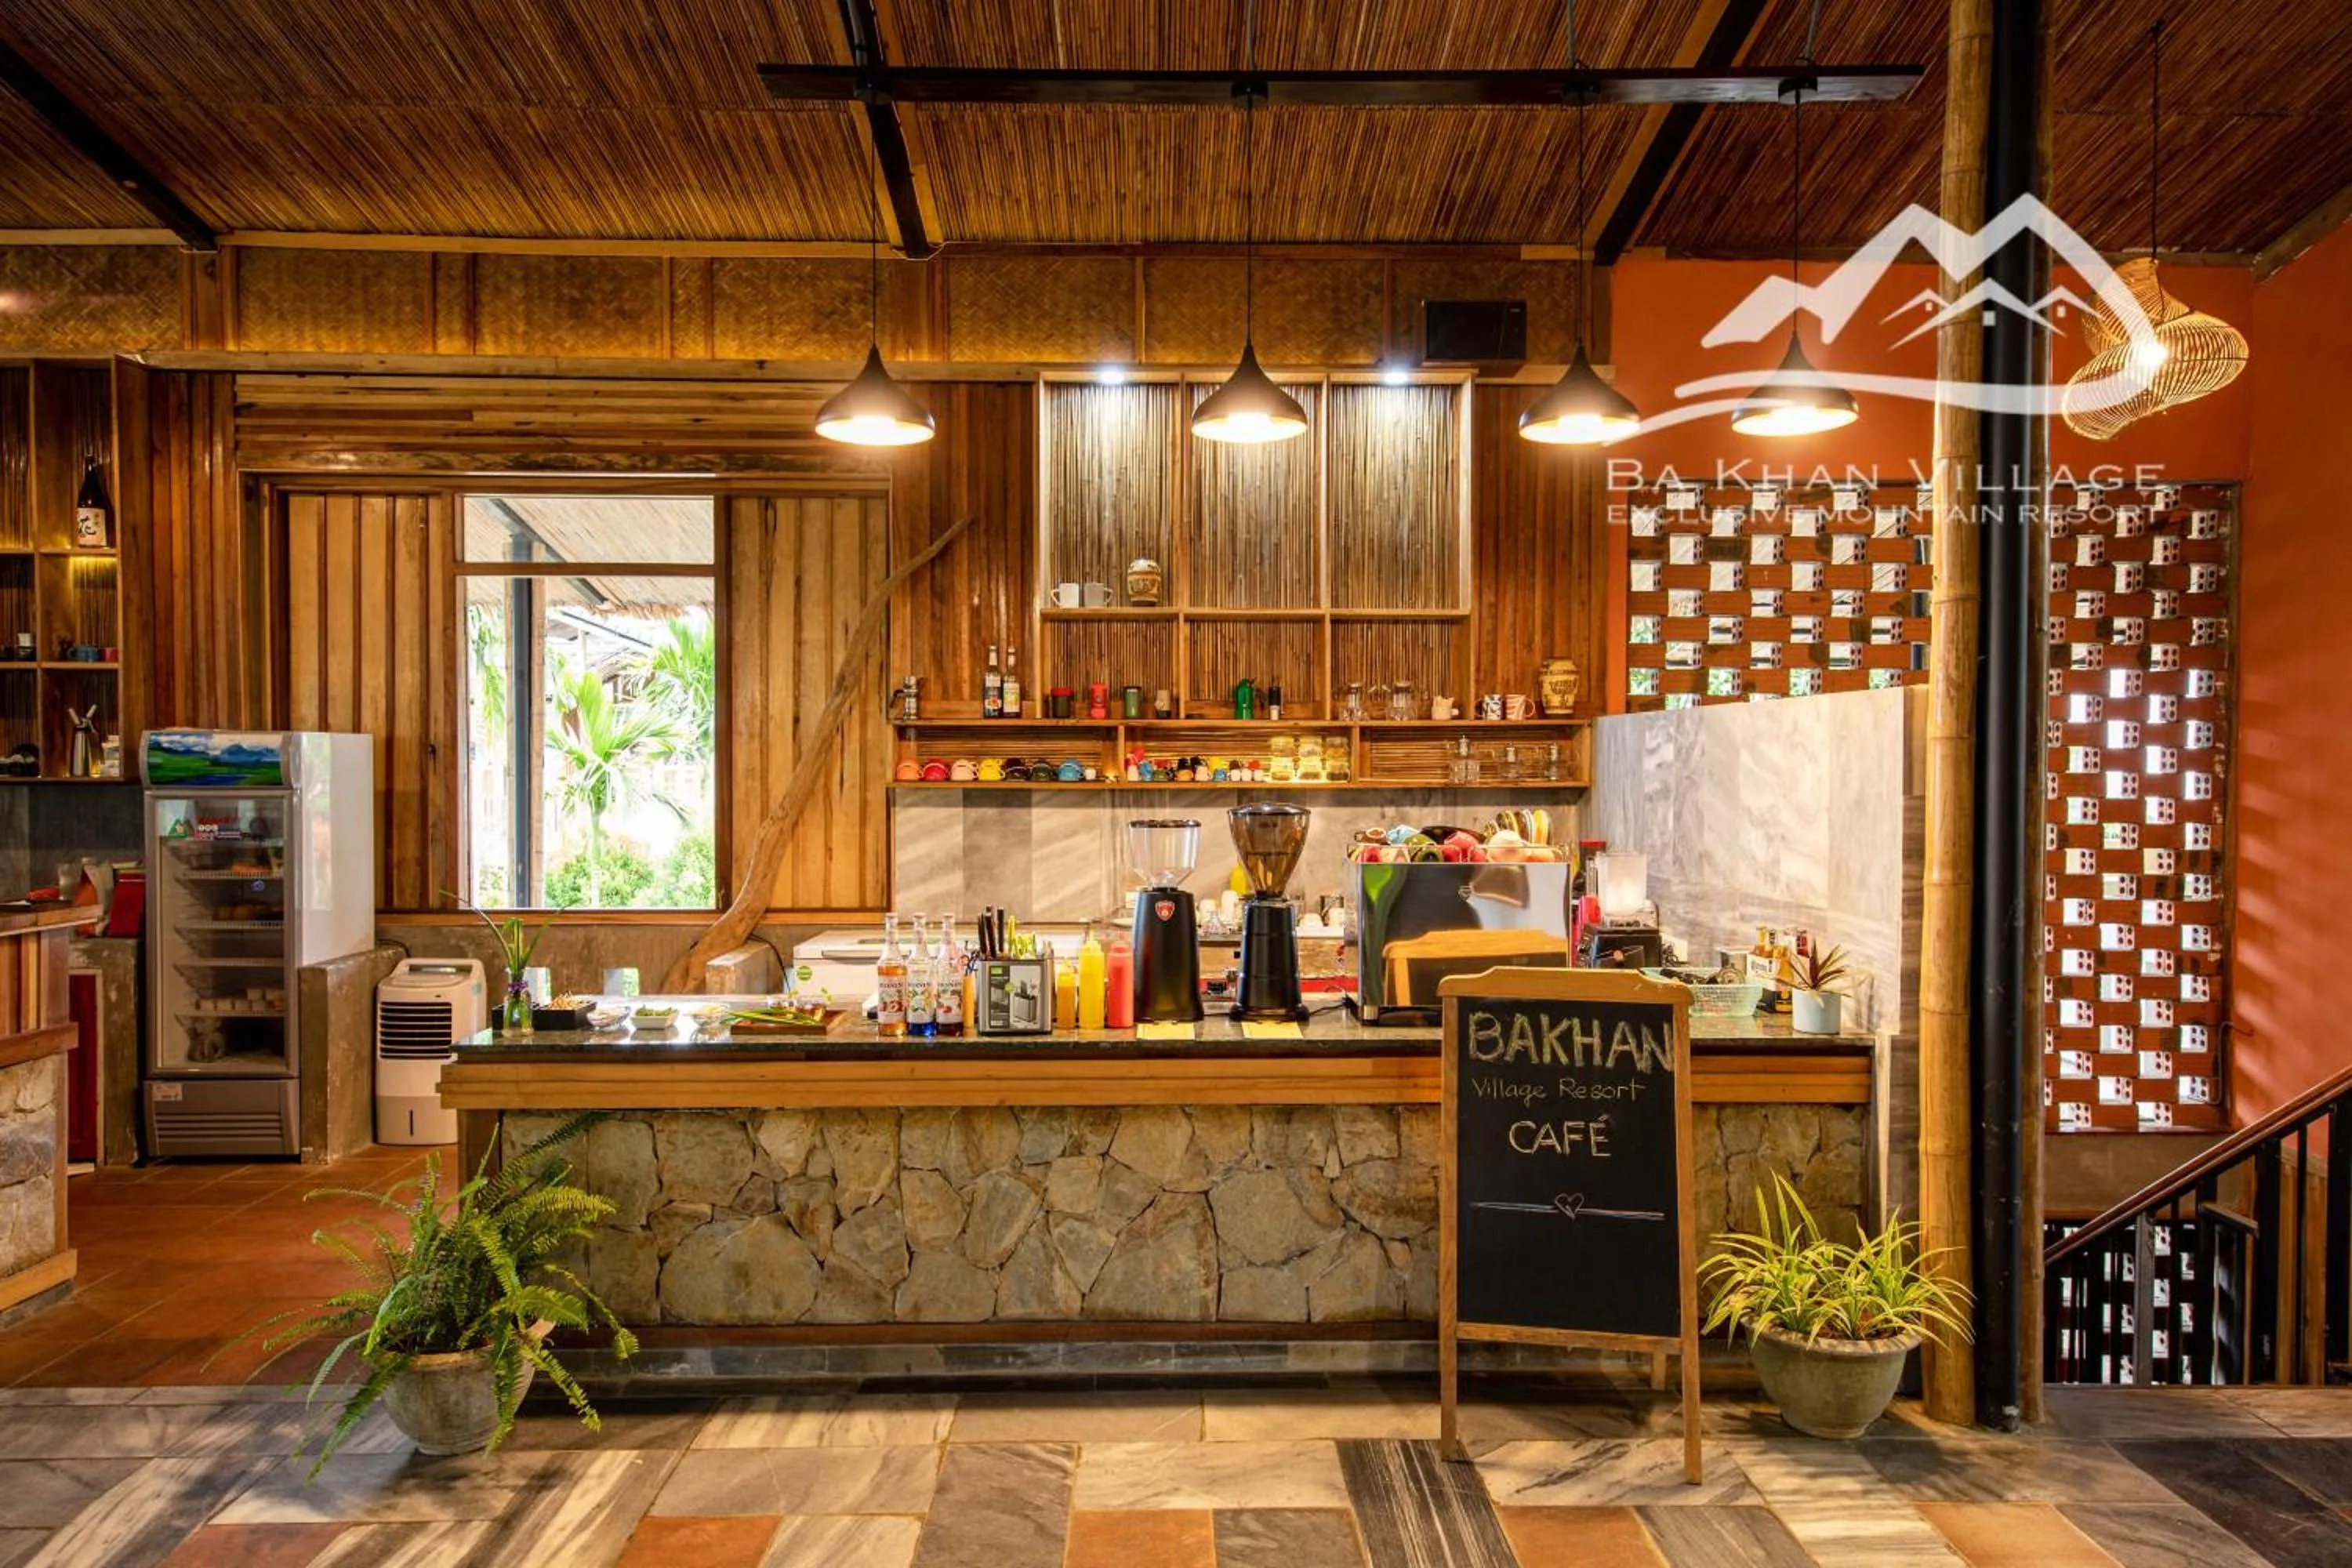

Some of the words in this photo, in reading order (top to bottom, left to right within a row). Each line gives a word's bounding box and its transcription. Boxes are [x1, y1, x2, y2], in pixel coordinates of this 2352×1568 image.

[1468, 1010, 1675, 1073] BAKHAN
[1472, 1077, 1547, 1107] Village
[1559, 1076, 1646, 1101] Resort
[1508, 1114, 1611, 1156] CAFÉ
